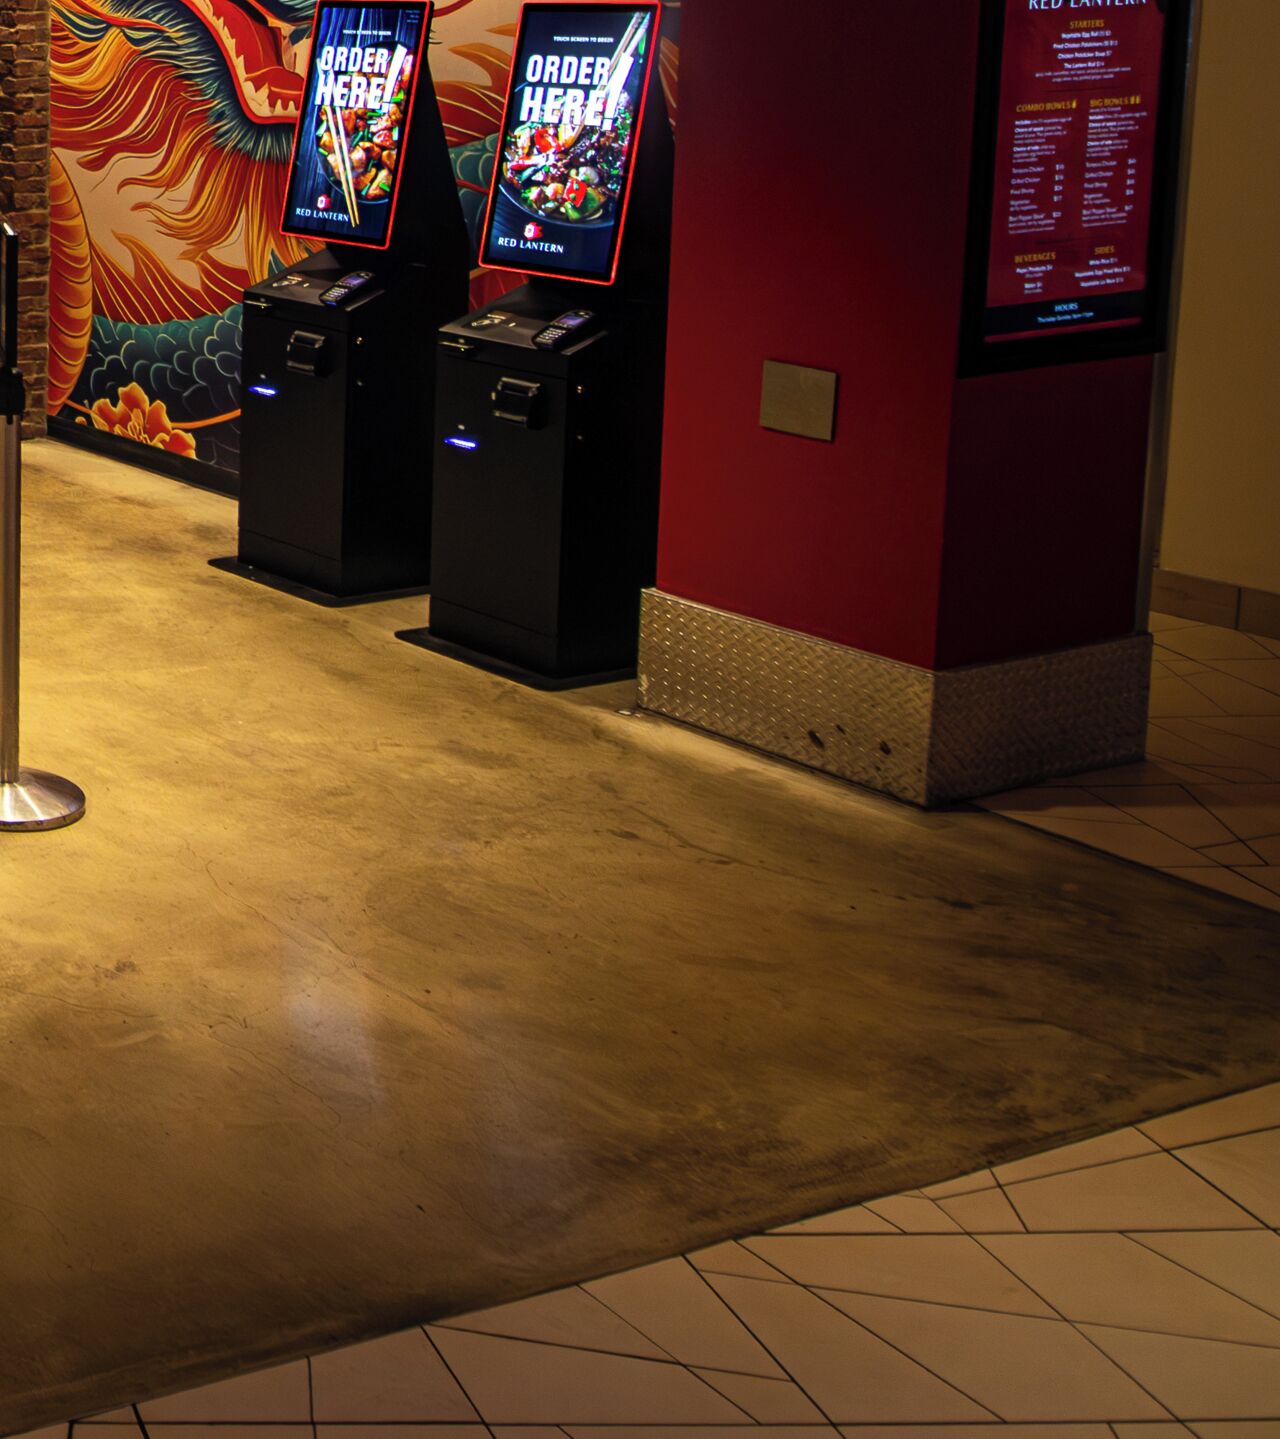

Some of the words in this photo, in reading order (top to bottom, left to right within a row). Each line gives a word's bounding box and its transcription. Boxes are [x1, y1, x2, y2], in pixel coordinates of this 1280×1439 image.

[320, 45, 389, 74] ORDER
[526, 54, 611, 85] ORDER
[315, 44, 407, 113] HERE!
[520, 53, 634, 131] HERE!
[296, 208, 311, 217] RED
[313, 210, 349, 222] LANTERN
[498, 237, 517, 248] RED
[520, 240, 563, 253] LANTERN
